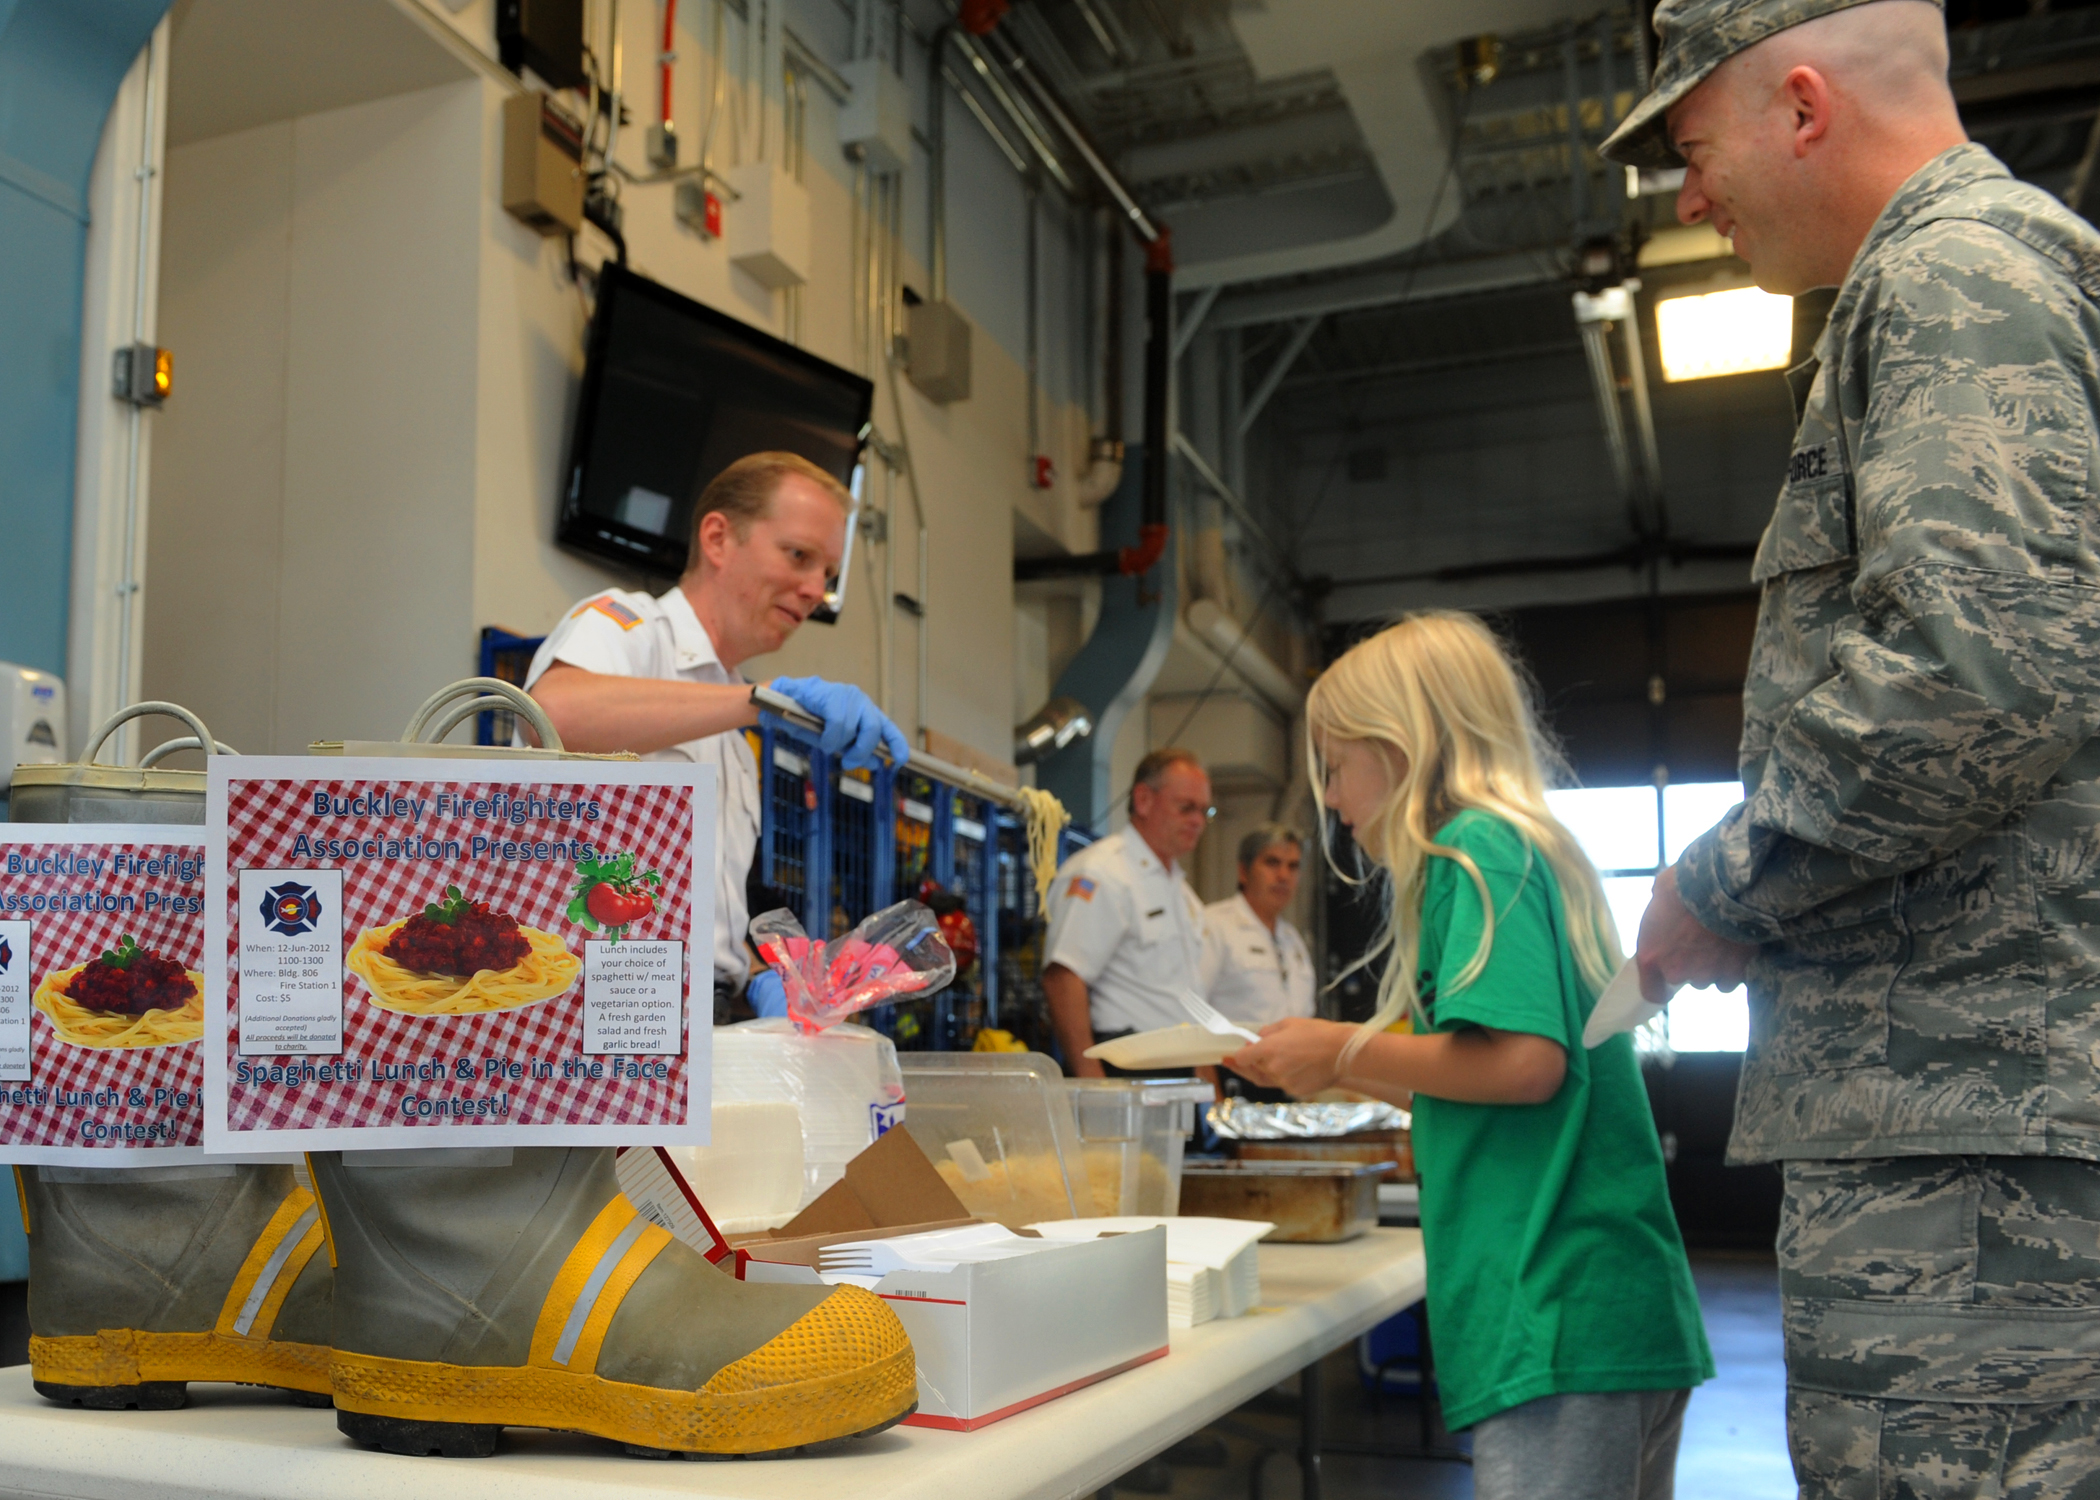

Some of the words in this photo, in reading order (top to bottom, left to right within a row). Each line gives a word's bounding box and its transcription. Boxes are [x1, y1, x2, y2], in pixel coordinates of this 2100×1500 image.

[1788, 447, 1828, 482] ORCE
[313, 791, 426, 823] Buckley
[436, 793, 600, 825] Firefighters
[291, 834, 461, 860] Association
[471, 836, 618, 862] Presents...
[6, 852, 105, 881] Buckley
[144, 891, 205, 913] Pres
[246, 944, 275, 953] When:
[278, 944, 330, 953] 12-Jun-2012
[600, 945, 627, 954] Lunch
[630, 945, 667, 954] includes
[278, 956, 324, 965] 1100-1300
[601, 960, 622, 969] your
[624, 959, 654, 968] choice
[656, 959, 666, 968] of
[244, 969, 276, 977] Where:
[278, 969, 300, 979] Bldg.
[302, 969, 319, 977] 806
[591, 972, 634, 983] spaghetti
[636, 972, 649, 981] w/
[651, 973, 676, 981] meat
[280, 981, 297, 990] Fire
[298, 981, 329, 990] Station
[331, 981, 337, 990] 1
[609, 987, 636, 995] sauce
[638, 987, 648, 995] or
[650, 987, 656, 995] a
[255, 994, 278, 1003] Cost:
[280, 993, 291, 1003] $5
[591, 1000, 639, 1010] vegetarian
[641, 1000, 674, 1010] option.
[245, 1015, 281, 1023] (Additional
[316, 1015, 337, 1023] gladly
[598, 1013, 606, 1021] A
[608, 1013, 631, 1021] fresh
[633, 1013, 666, 1023] garden
[275, 1024, 308, 1032] accepted)
[597, 1026, 621, 1035] salad
[623, 1026, 640, 1035] and
[643, 1026, 667, 1035] fresh
[245, 1034, 255, 1042] All
[255, 1034, 285, 1042] proceeds
[309, 1033, 336, 1041] donated
[275, 1043, 282, 1051] to
[603, 1040, 628, 1050] garlic
[630, 1040, 661, 1049] bread!
[236, 1059, 362, 1088] Spaghetti
[371, 1057, 446, 1081] Lunch
[455, 1057, 475, 1080] &
[485, 1056, 523, 1079] Pie
[531, 1057, 553, 1079] in
[562, 1056, 604, 1079] the
[613, 1057, 668, 1079] Face
[55, 1086, 120, 1107] Lunch
[128, 1087, 147, 1107] &
[154, 1087, 189, 1107] Pie
[401, 1093, 508, 1116] Contest!
[80, 1119, 177, 1140] Contest!
